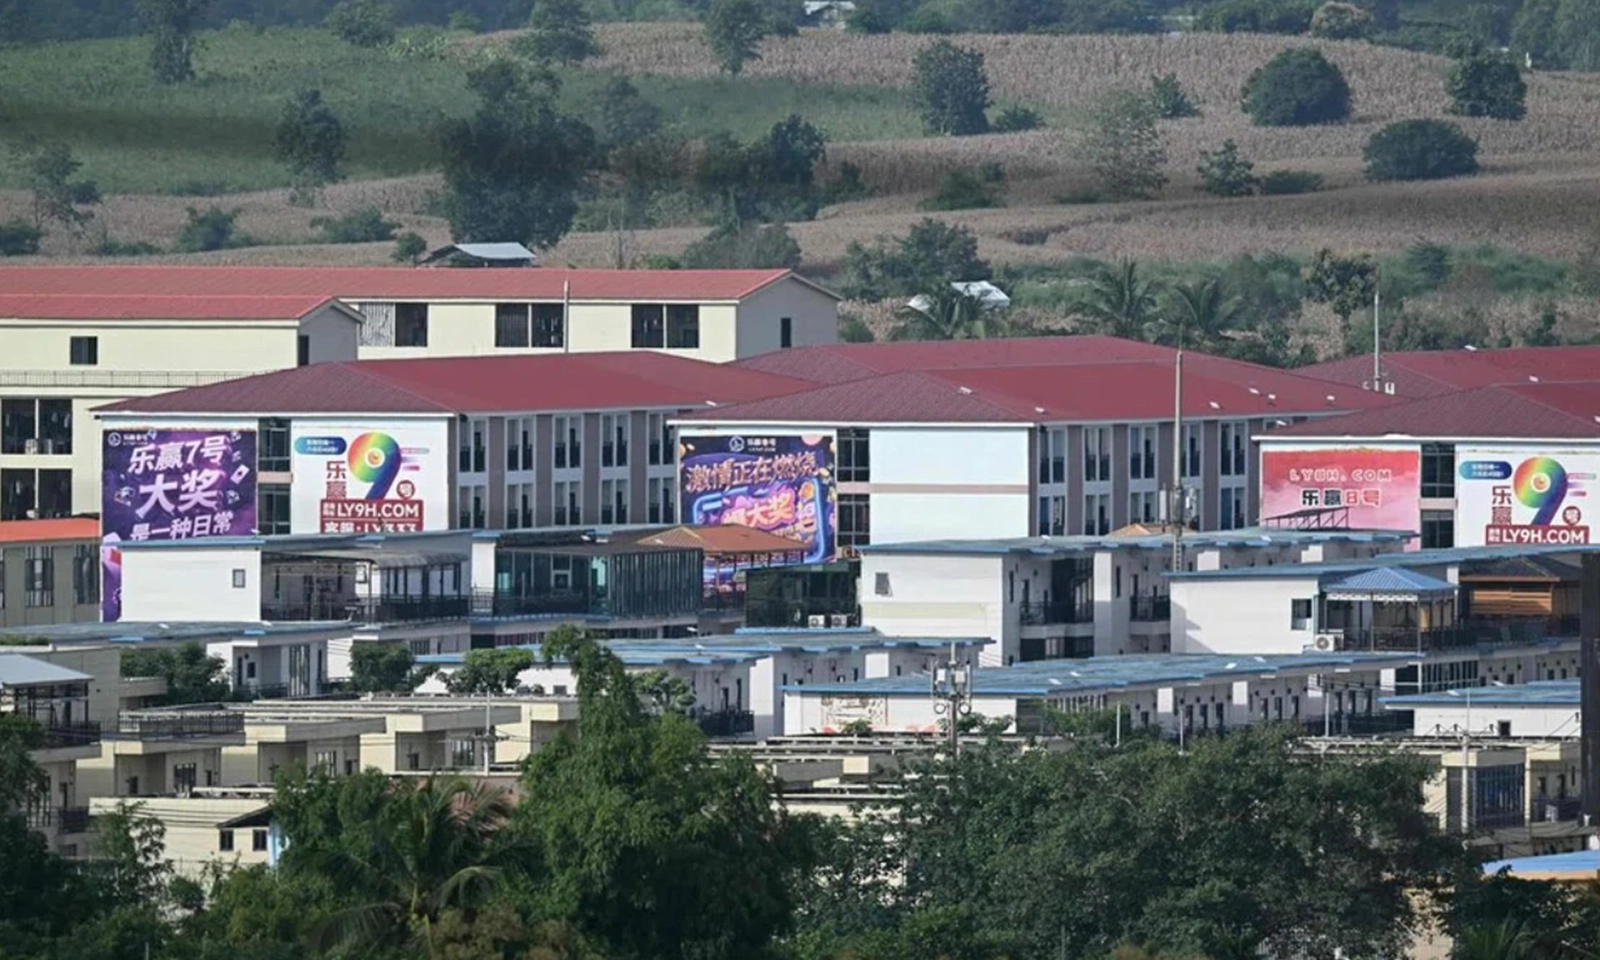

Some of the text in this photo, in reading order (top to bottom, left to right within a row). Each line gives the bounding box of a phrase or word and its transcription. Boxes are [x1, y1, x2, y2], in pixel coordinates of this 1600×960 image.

[127, 435, 227, 474] 乐赢7号
[686, 452, 818, 492] 激情正在燃烧
[135, 469, 222, 519] 大奖
[1301, 488, 1381, 507] 乐赢8号
[337, 503, 419, 517] LY9H.COM
[130, 511, 234, 541] 是一种日常
[1502, 529, 1585, 544] LY9H.COM
